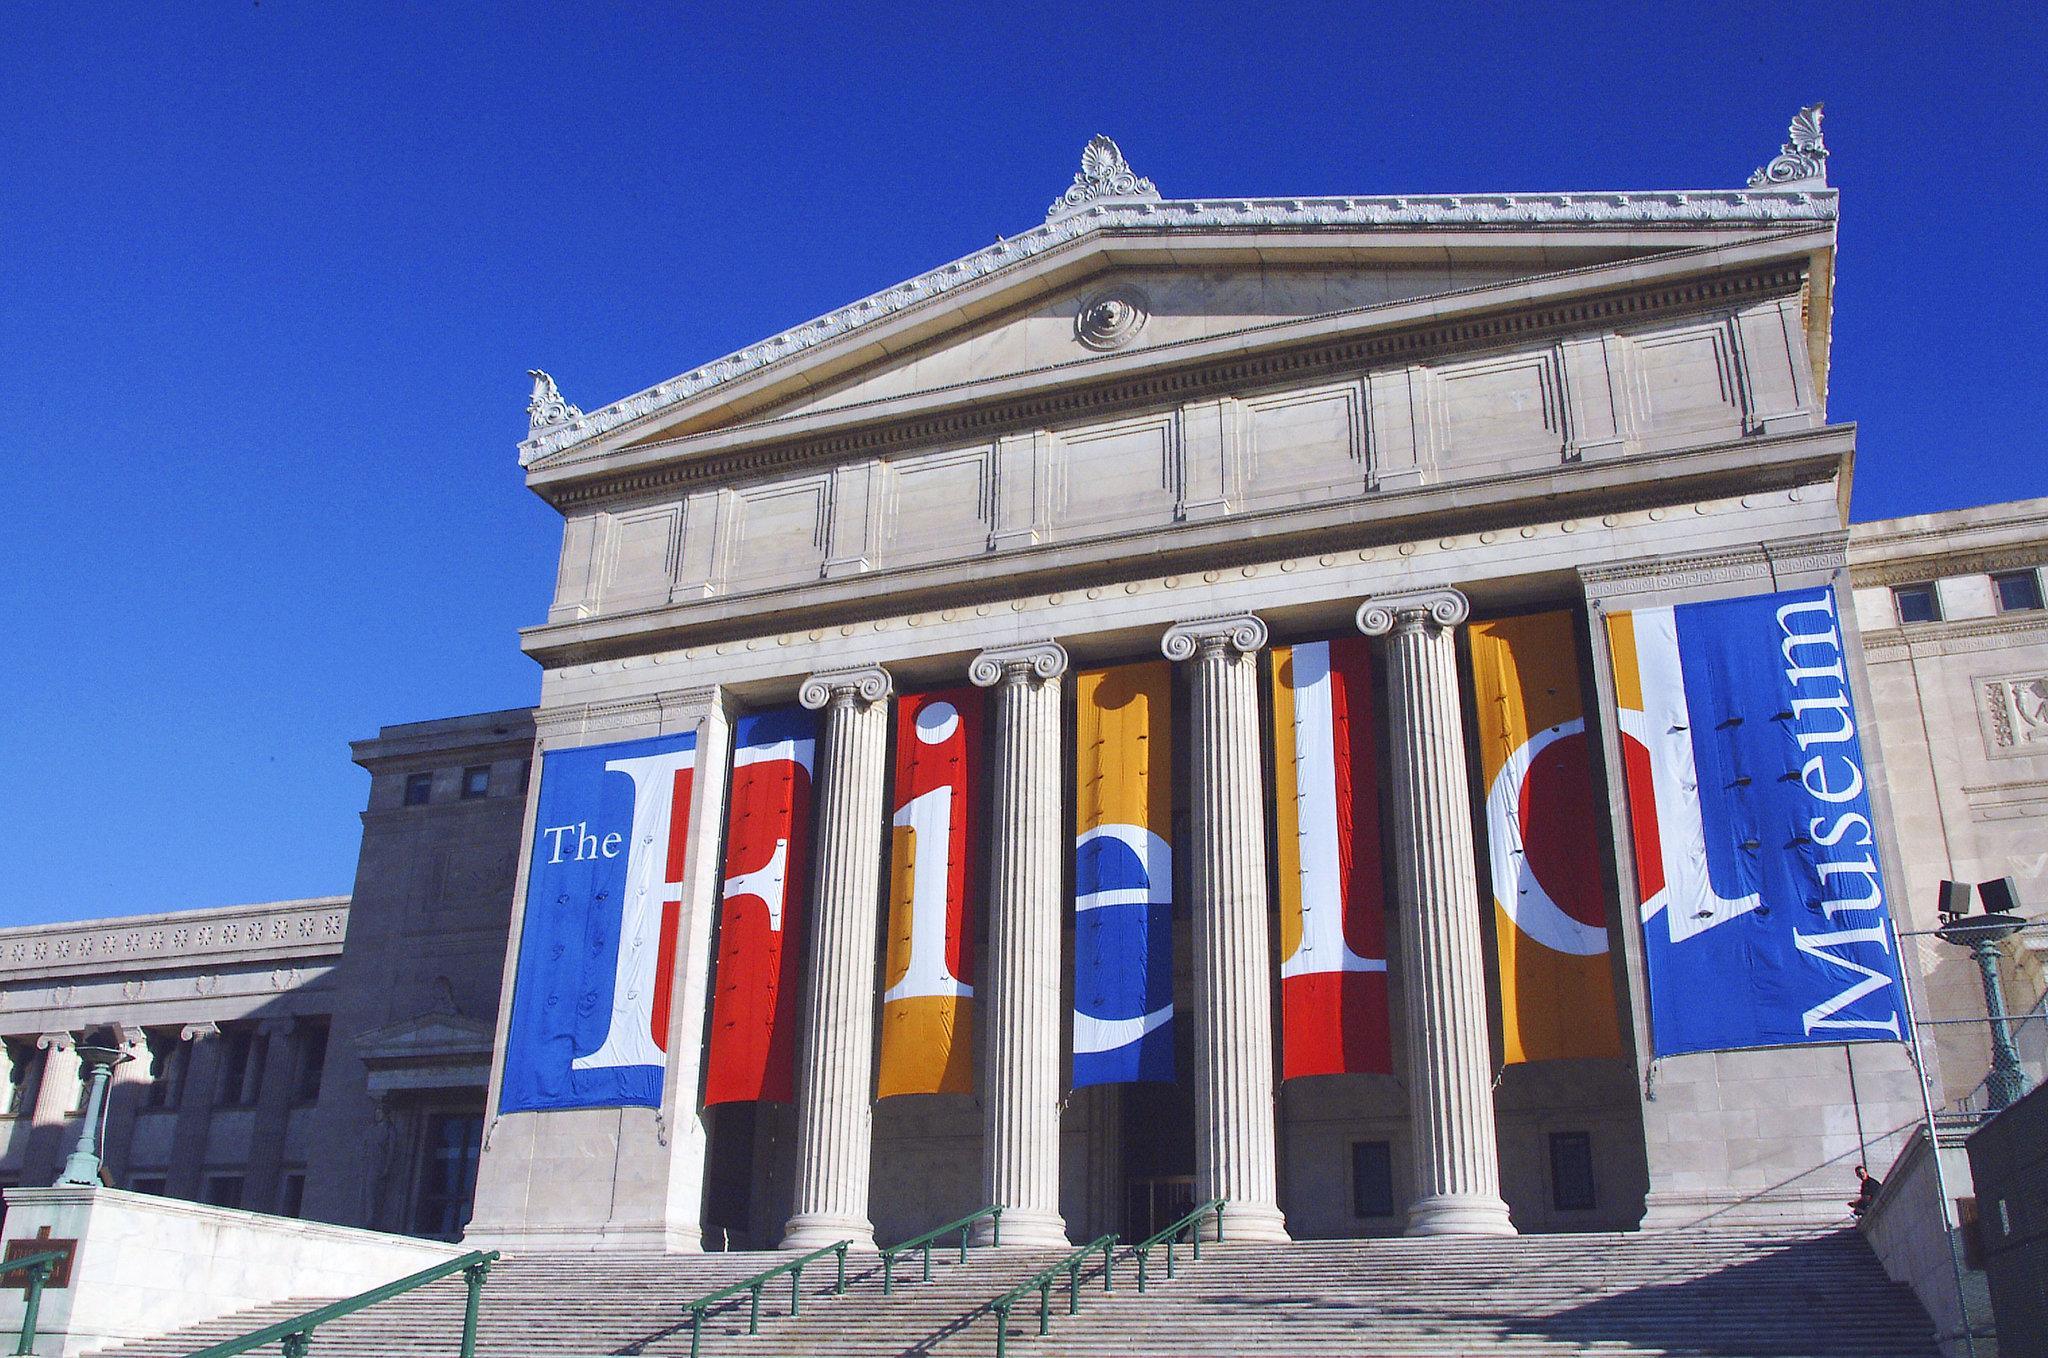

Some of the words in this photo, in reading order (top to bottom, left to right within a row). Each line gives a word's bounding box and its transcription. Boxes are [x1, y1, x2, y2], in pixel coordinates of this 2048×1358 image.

[543, 821, 623, 865] The
[572, 605, 1761, 1071] Field
[1775, 589, 1902, 1041] Museum
